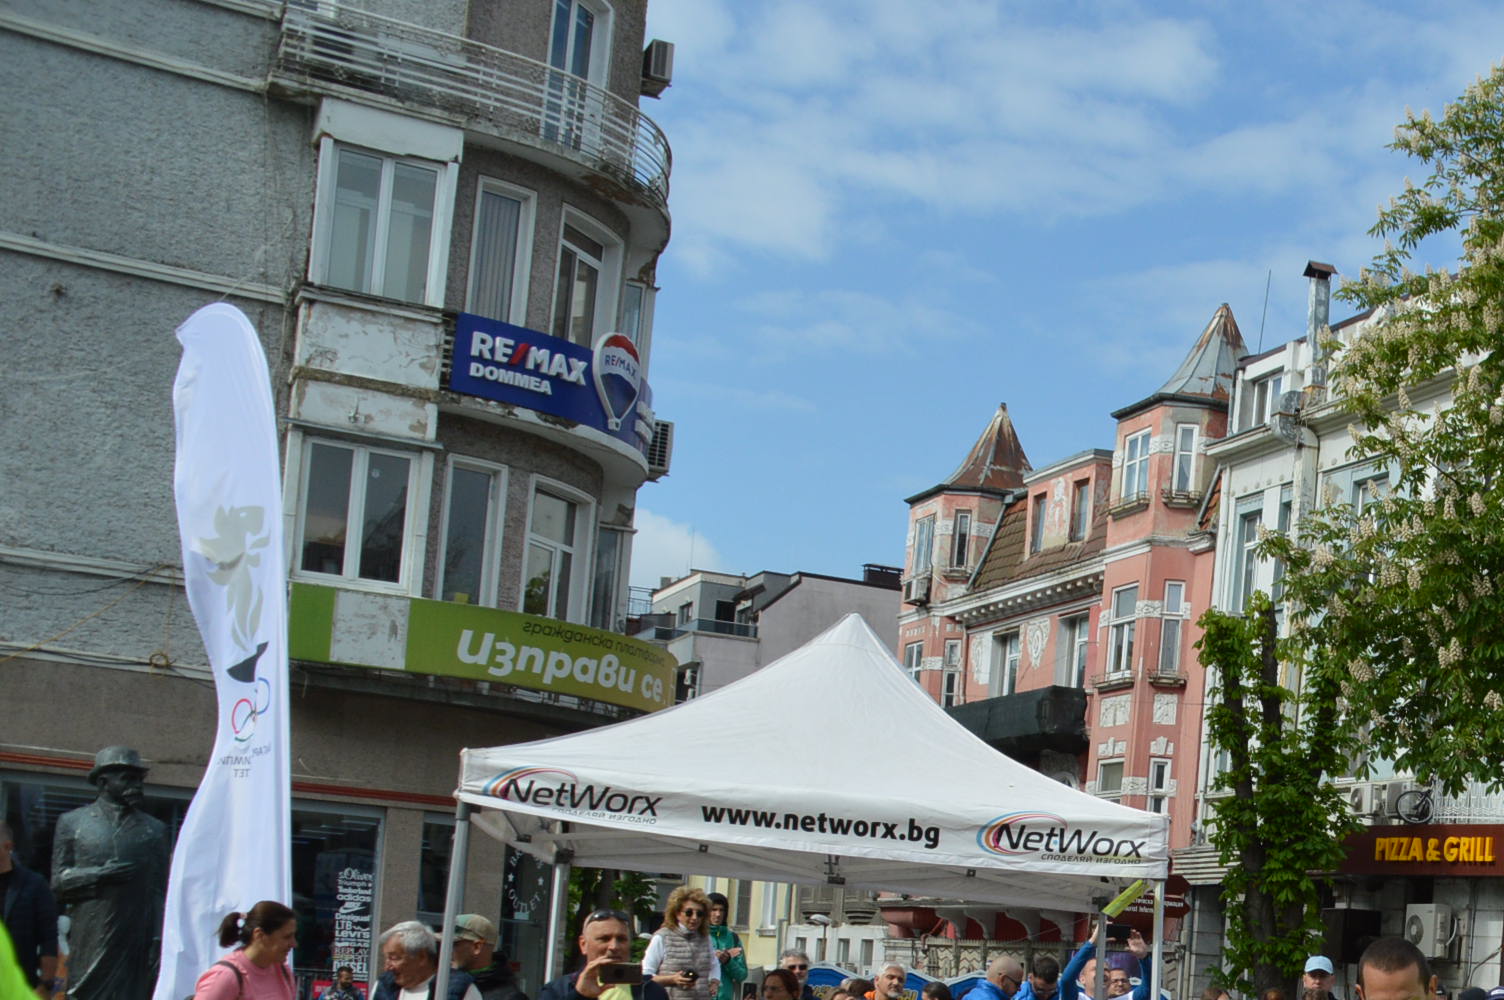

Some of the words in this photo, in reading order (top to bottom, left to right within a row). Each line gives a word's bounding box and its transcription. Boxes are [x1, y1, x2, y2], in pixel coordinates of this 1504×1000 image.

[470, 331, 587, 385] RE/MAX
[605, 353, 637, 379] RE/MAX
[470, 362, 552, 395] DOMMEA
[521, 621, 614, 649] гражданска
[457, 629, 637, 685] Изправи
[641, 673, 664, 703] се
[503, 778, 663, 816] NetWorx
[701, 805, 940, 850] www.networx.bg
[992, 822, 1146, 858] NetWorx
[1375, 838, 1423, 861] PIZZA
[1426, 838, 1441, 861] &
[1444, 837, 1495, 862] GRILL
[336, 893, 371, 902] adidas
